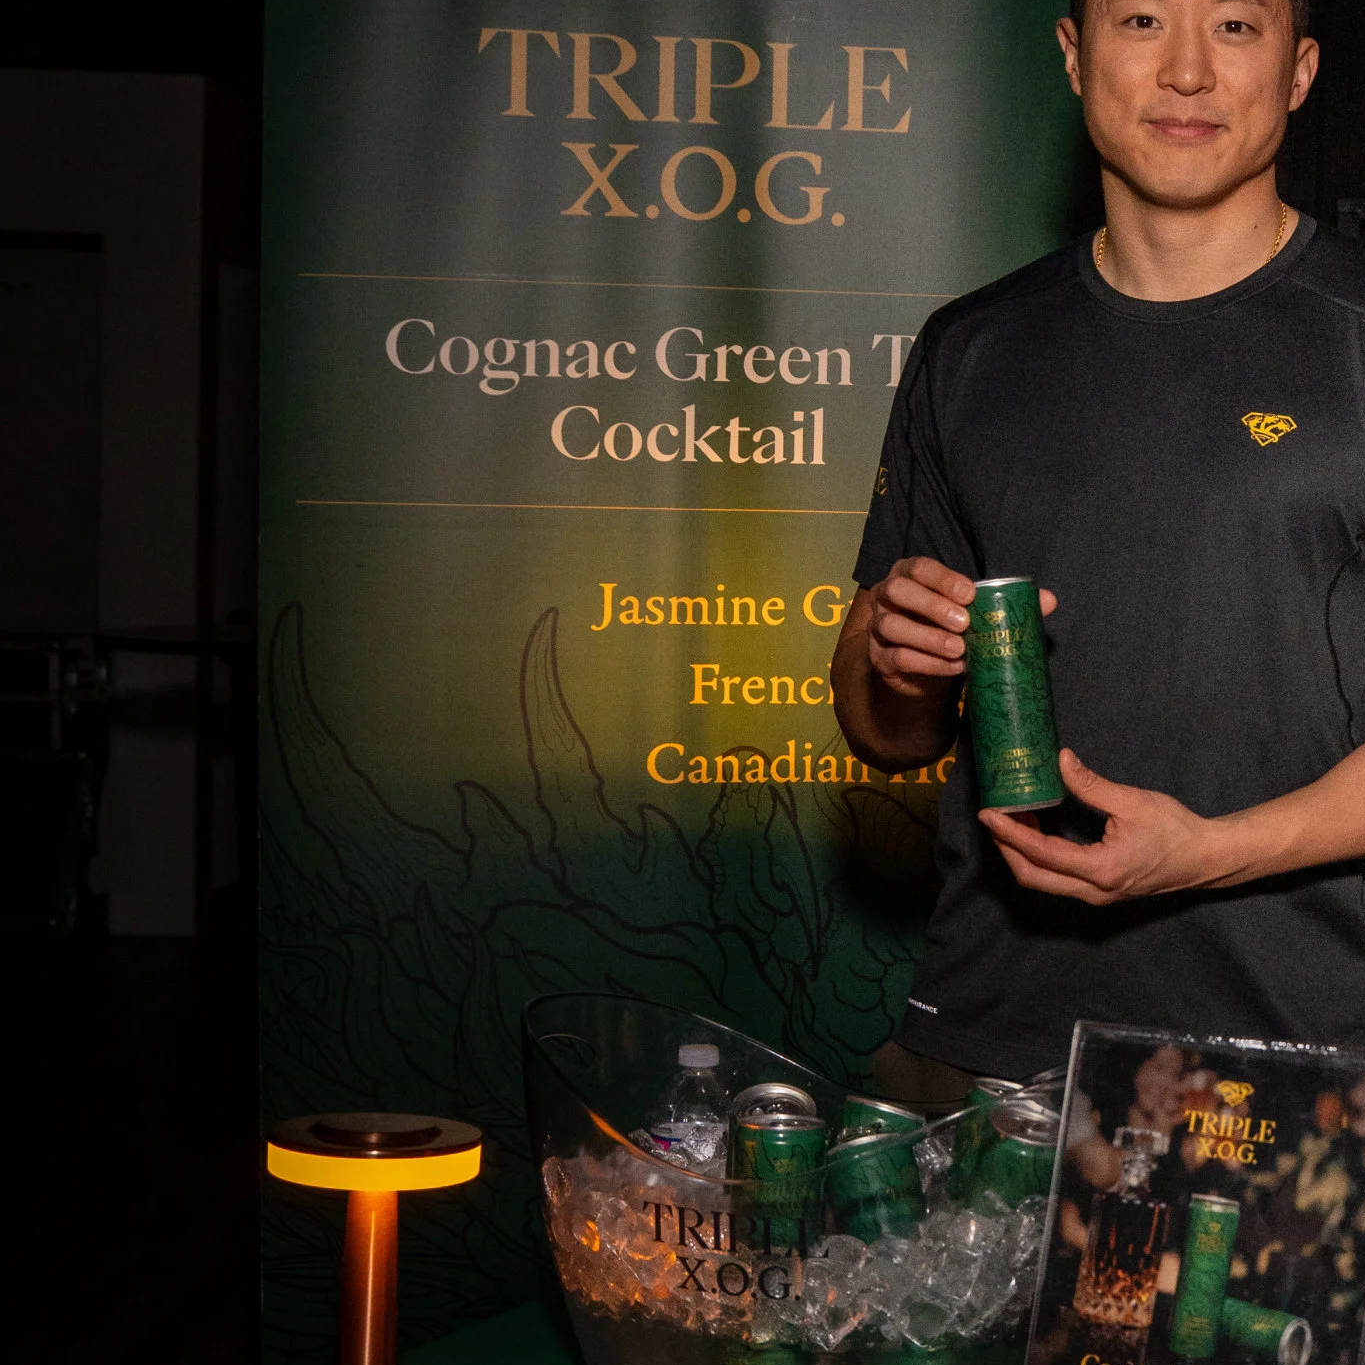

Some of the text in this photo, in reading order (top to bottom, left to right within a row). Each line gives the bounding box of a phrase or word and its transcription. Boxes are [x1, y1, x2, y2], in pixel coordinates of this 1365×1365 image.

[478, 27, 913, 134] TRIPLE
[560, 141, 847, 227] X.O.G.
[385, 318, 637, 396] Cognac
[655, 326, 853, 387] Green
[550, 404, 827, 466] Cocktail
[591, 582, 786, 632] Jasmine
[646, 742, 871, 786] Canadian
[1184, 1108, 1277, 1144] TRIPLE
[1195, 1136, 1258, 1165] X.O.G.
[642, 1200, 829, 1259] TRIPLE
[676, 1255, 801, 1300] X.O.G.
